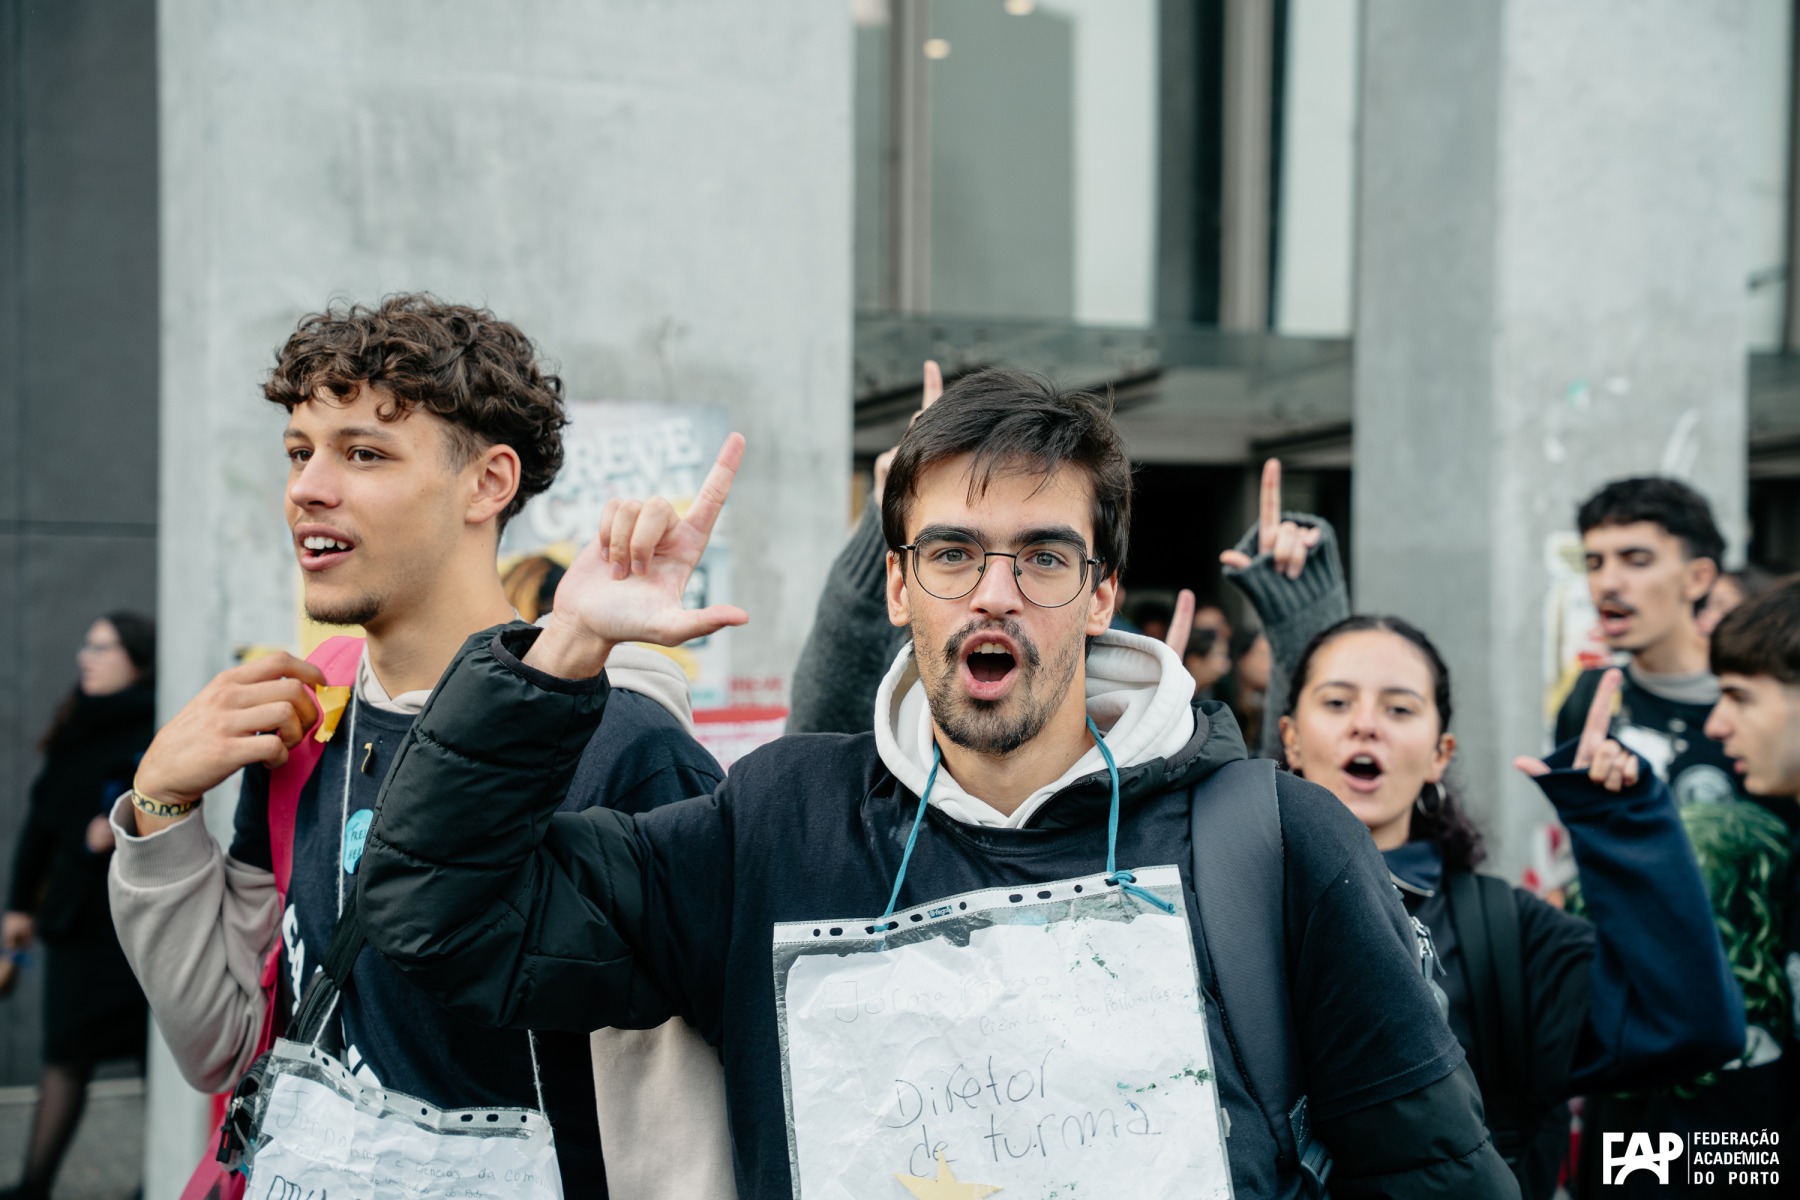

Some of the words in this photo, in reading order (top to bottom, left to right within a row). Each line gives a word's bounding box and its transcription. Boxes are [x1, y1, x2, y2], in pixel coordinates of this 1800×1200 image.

[555, 415, 704, 491] REVE
[886, 1047, 1054, 1129] Diretor
[478, 1167, 496, 1180] da
[909, 1123, 958, 1178] de
[983, 1101, 1162, 1163] turma
